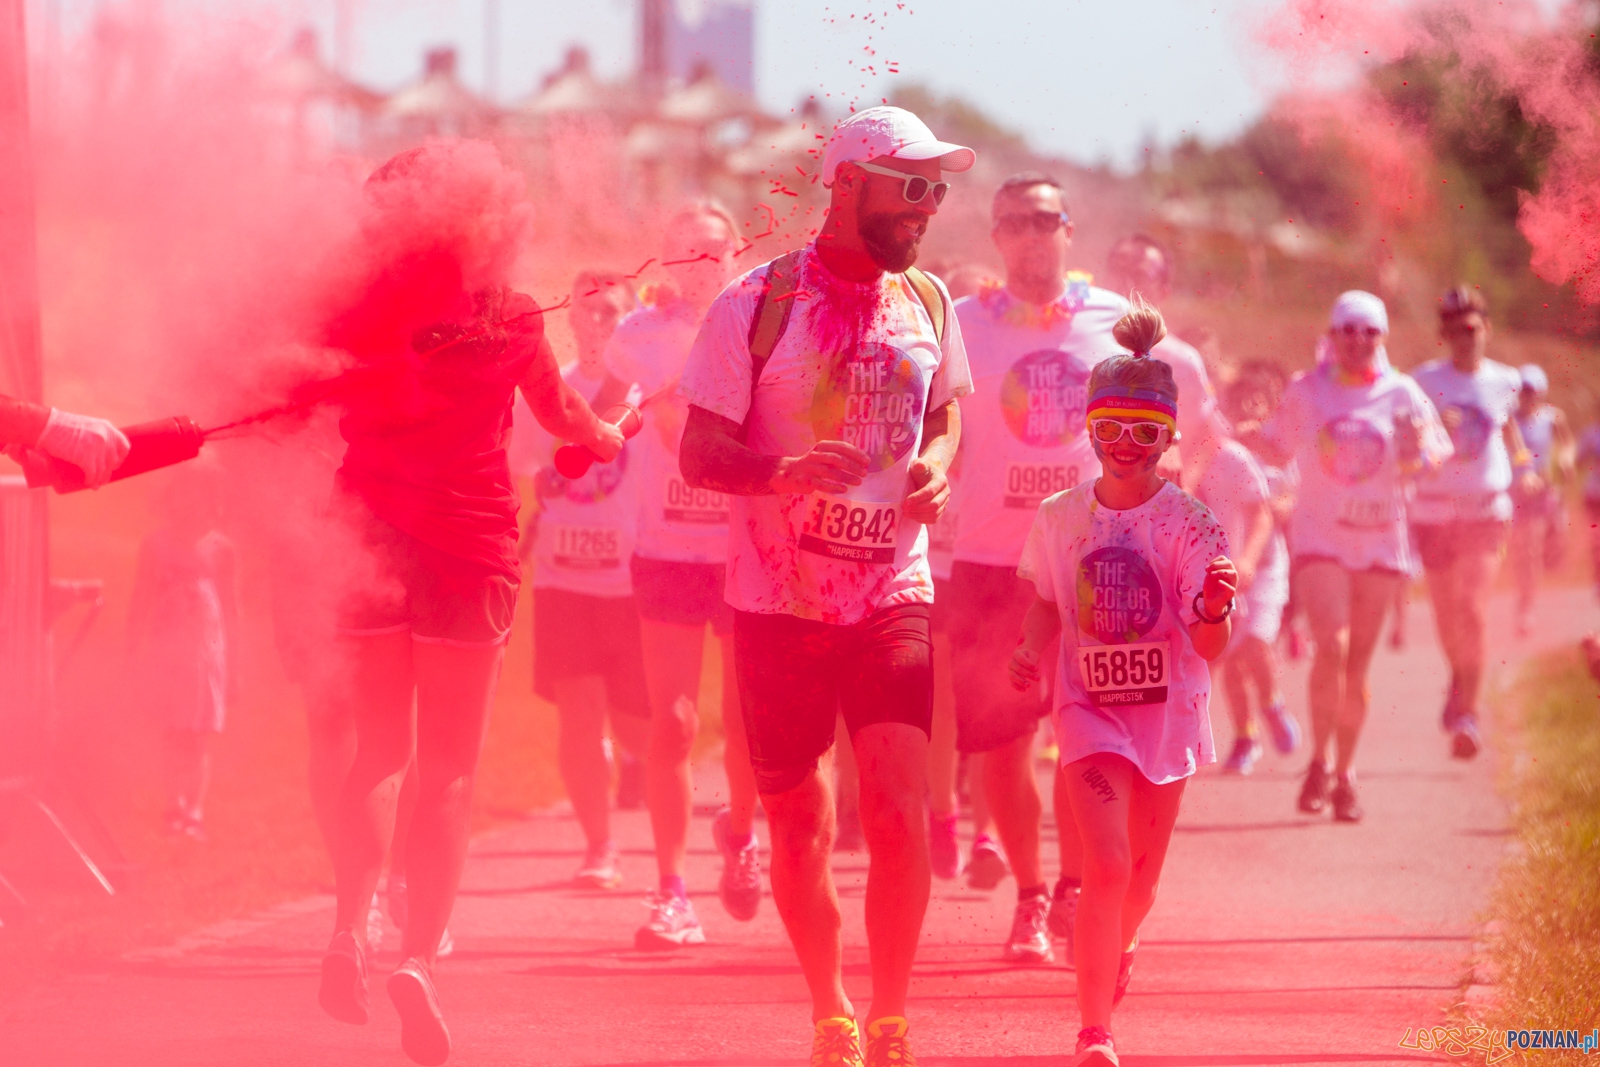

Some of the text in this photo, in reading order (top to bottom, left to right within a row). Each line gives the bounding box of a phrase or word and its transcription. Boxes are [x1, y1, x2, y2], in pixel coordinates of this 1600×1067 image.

[846, 361, 887, 393] THE
[1026, 364, 1061, 388] THE
[843, 392, 915, 424] COLOR
[1027, 385, 1087, 412] COLOR
[1027, 412, 1066, 436] RUN
[843, 425, 885, 455] RUN
[1008, 466, 1079, 495] 09858
[812, 498, 896, 543] 13842
[560, 528, 618, 556] 11265
[1094, 561, 1126, 586] THE
[1093, 587, 1150, 610] COLOR
[1094, 611, 1128, 633] RUN
[1083, 648, 1163, 688] 15859
[1081, 766, 1119, 803] HAPPY
